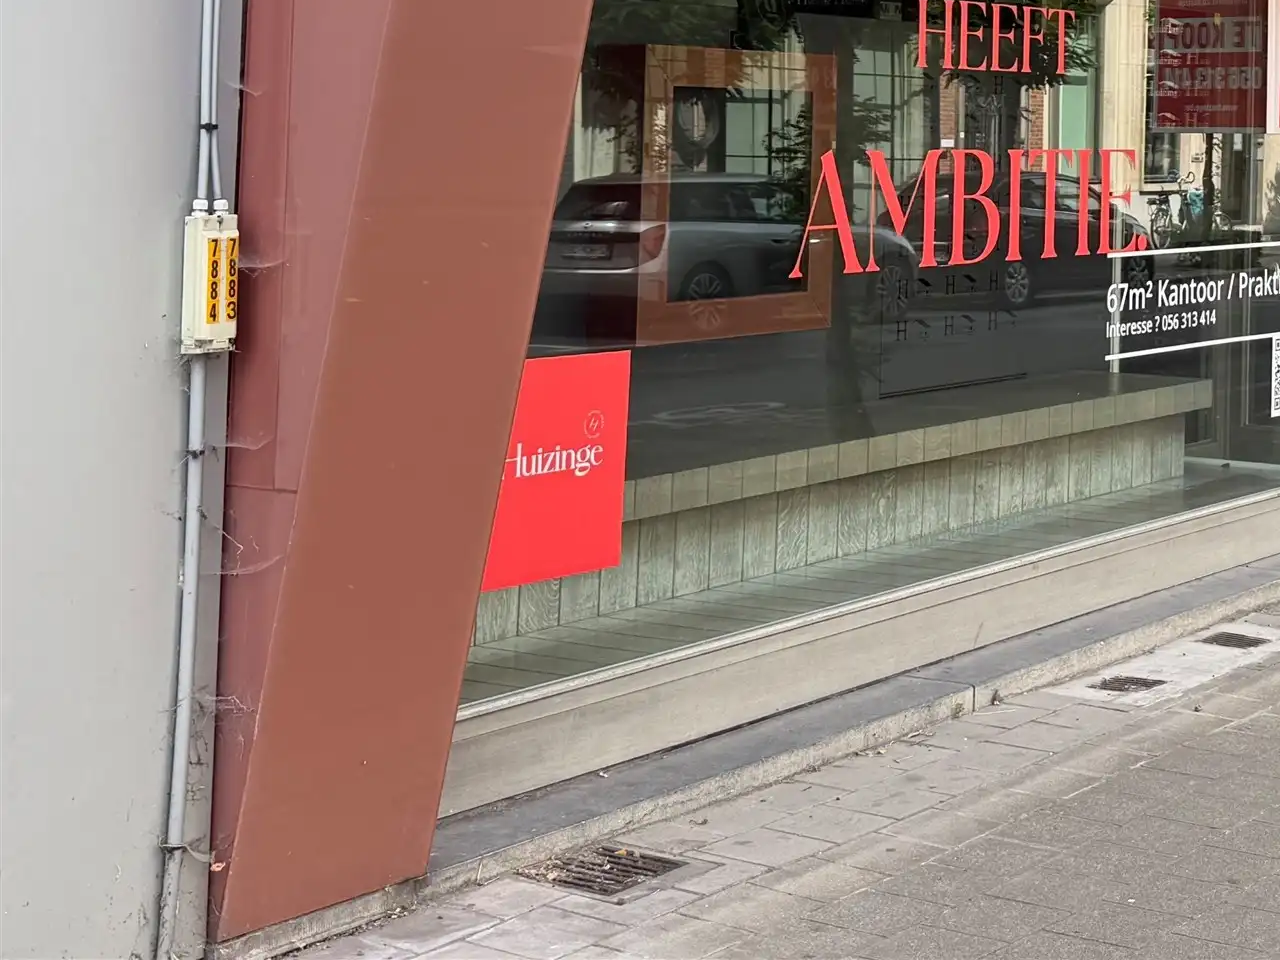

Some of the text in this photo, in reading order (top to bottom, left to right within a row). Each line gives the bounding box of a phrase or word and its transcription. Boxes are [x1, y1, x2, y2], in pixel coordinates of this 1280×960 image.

[788, 148, 1148, 279] AMBITIE.
[209, 238, 220, 322] 7884
[226, 238, 237, 320] 7883
[1157, 279, 1225, 307] Kantoor
[1227, 273, 1236, 300] /
[1105, 319, 1153, 338] Interesse
[1161, 312, 1180, 331] 056
[1180, 310, 1199, 329] 313
[1199, 308, 1217, 326] 414
[502, 442, 604, 478] Huizinge
